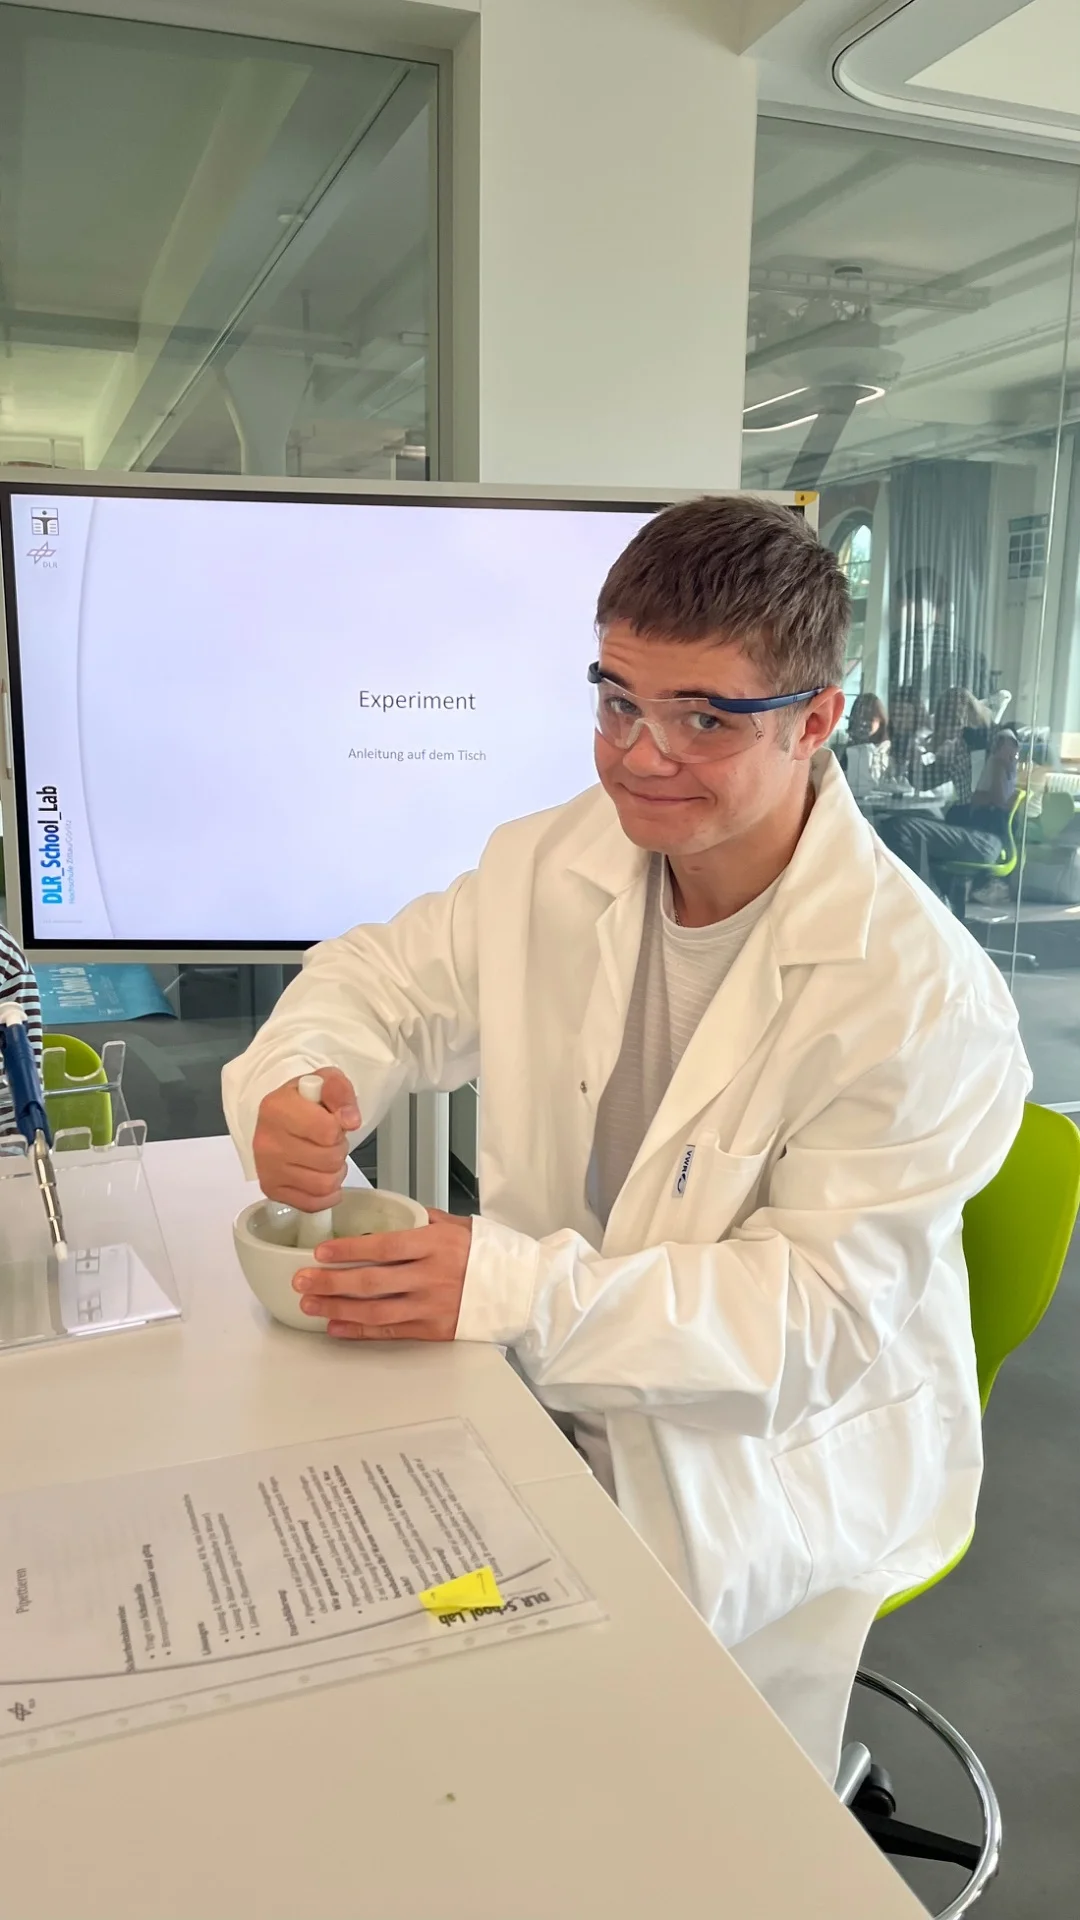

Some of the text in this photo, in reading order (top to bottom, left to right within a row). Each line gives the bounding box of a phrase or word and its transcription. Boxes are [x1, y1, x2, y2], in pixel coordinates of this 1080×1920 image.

[359, 690, 476, 712] Experiment
[348, 748, 487, 762] Anleitung auf dem Tisch
[36, 785, 64, 904] DLR_School_Lab
[681, 1150, 693, 1172] VWR
[16, 1567, 32, 1614] Pipettieren
